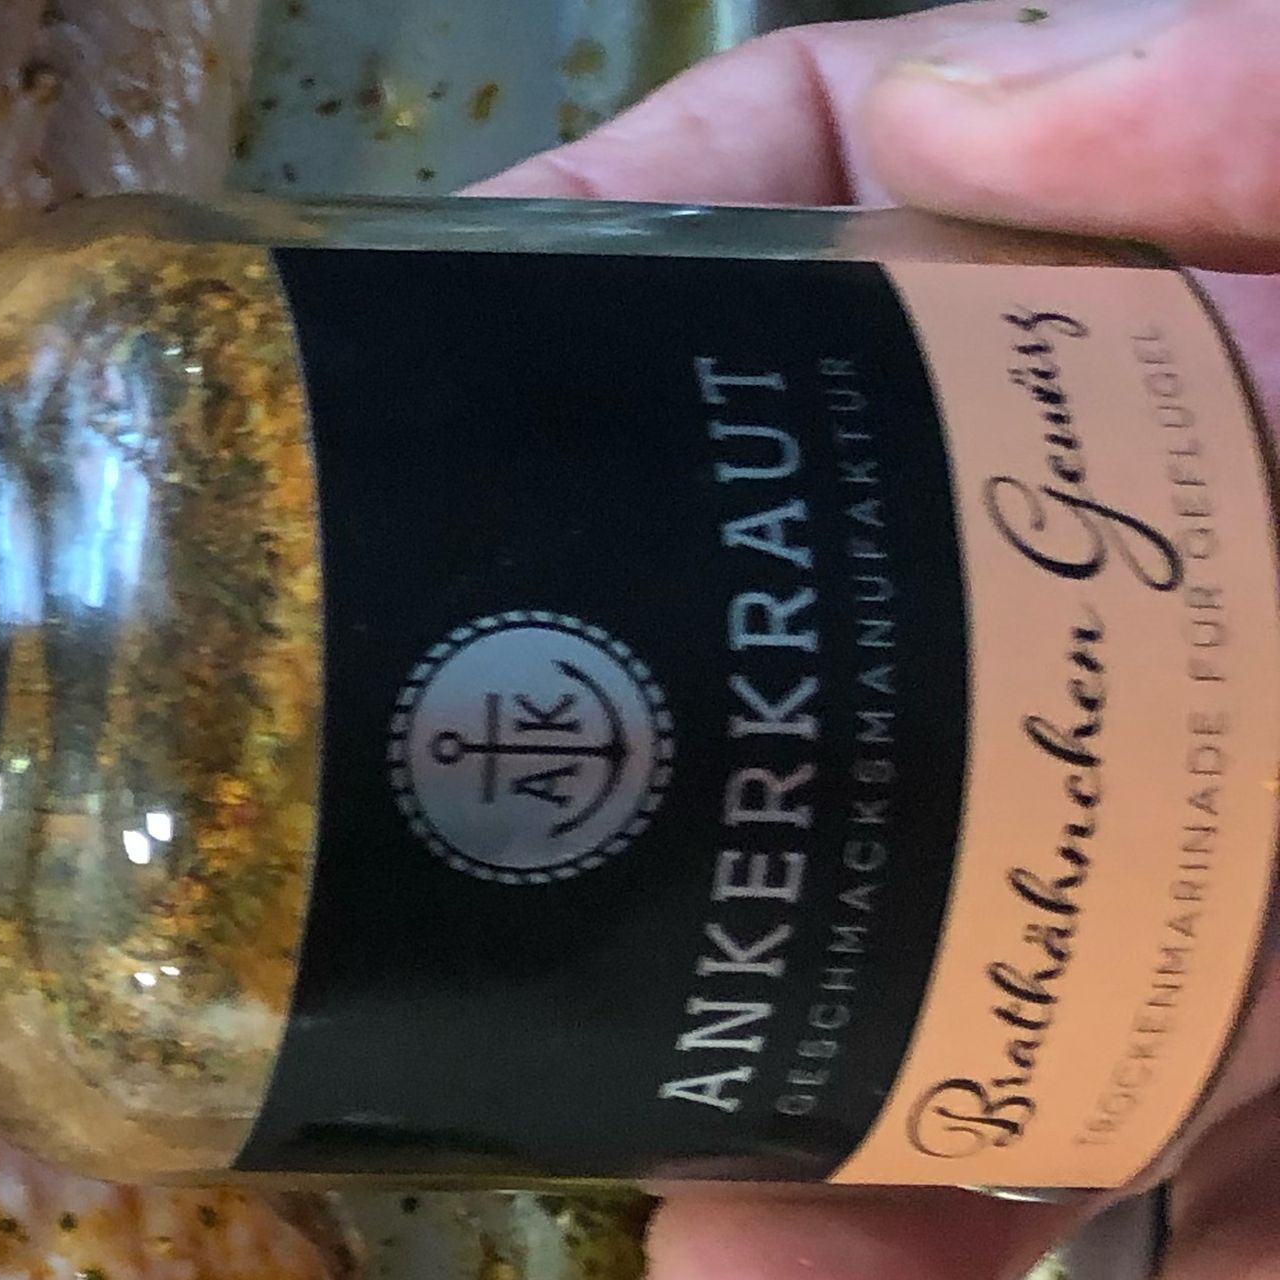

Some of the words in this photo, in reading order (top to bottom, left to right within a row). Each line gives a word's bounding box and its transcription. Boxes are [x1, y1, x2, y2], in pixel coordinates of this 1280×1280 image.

[984, 301, 1183, 592] Gewürz
[656, 354, 824, 1114] ANKERKRAUT
[777, 354, 895, 1116] GESCHMACKSMANUFAKTUR
[905, 612, 1105, 1157] Brathähnchen
[1071, 711, 1229, 1146] TROCKENMARINADE
